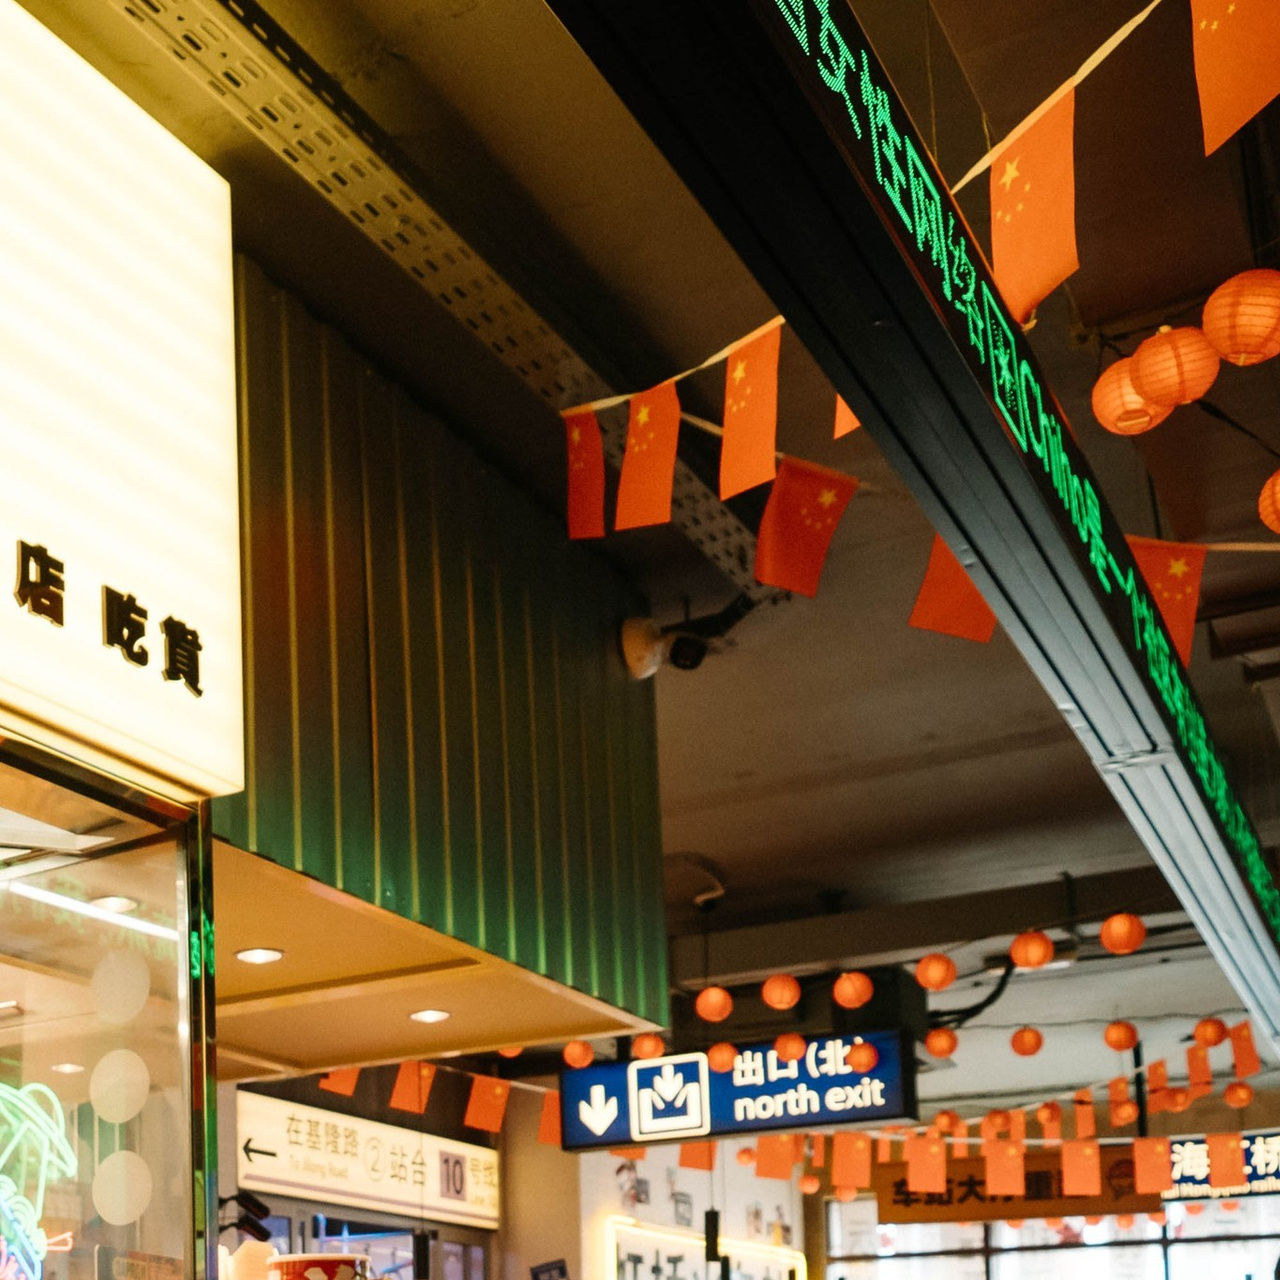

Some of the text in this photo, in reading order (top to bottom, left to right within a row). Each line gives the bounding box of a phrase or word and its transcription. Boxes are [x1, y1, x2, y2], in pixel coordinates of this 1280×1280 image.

[734, 1077, 886, 1122] north exit
[442, 1157, 465, 1196] 10
